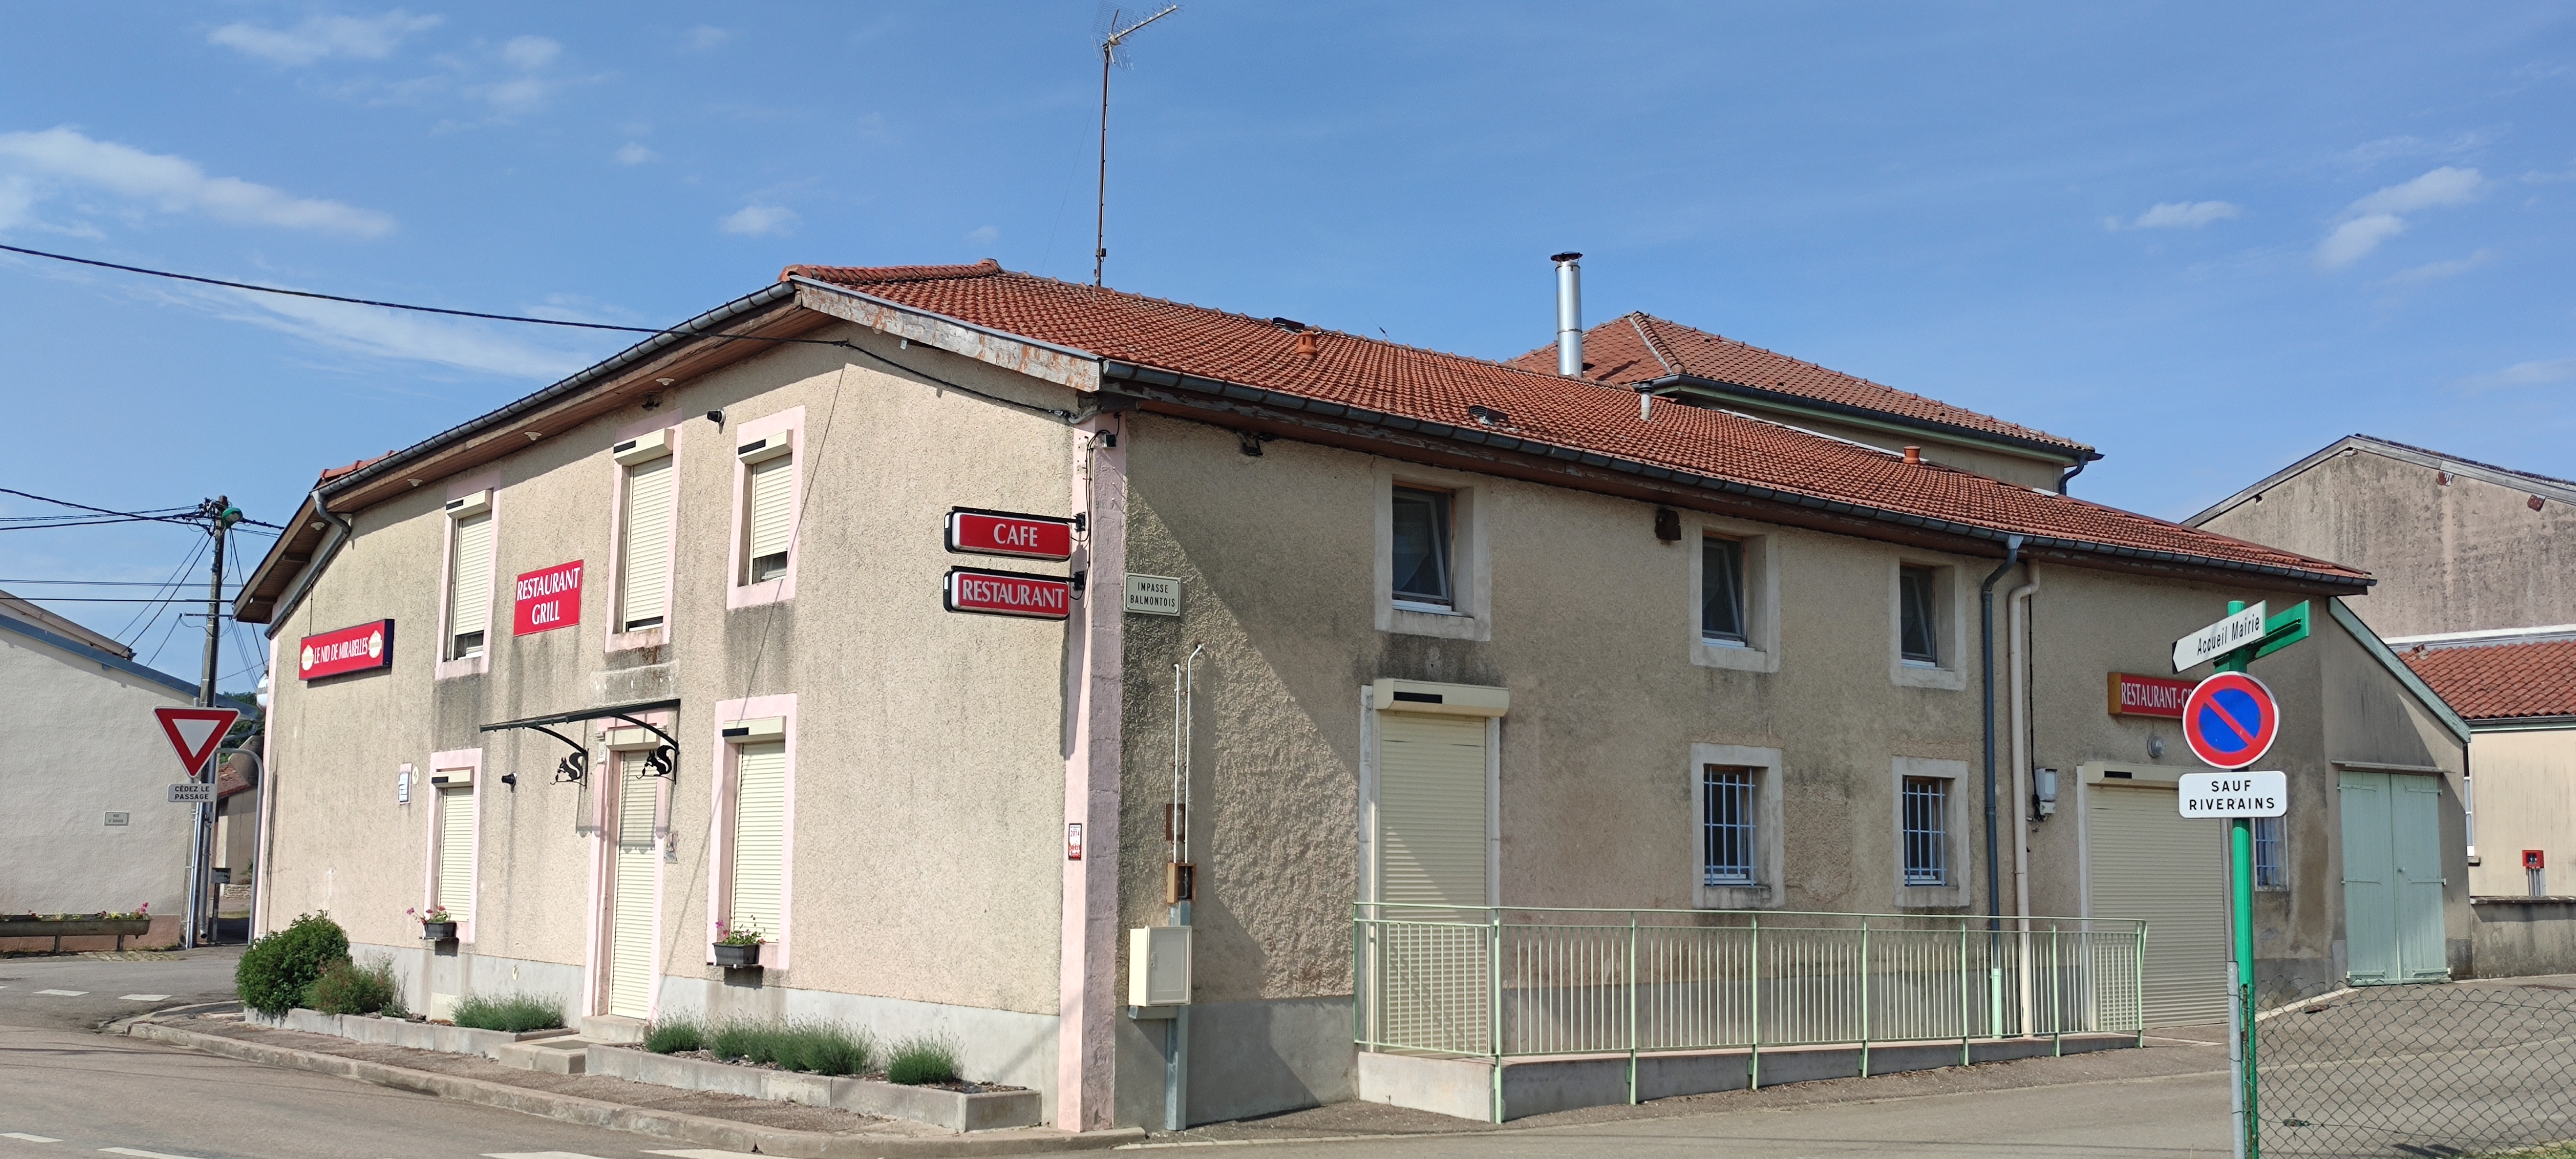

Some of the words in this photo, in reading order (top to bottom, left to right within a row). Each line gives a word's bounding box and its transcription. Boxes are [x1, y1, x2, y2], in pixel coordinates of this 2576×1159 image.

[994, 523, 1037, 547] CAFE
[517, 567, 580, 601] RESTAURANT
[963, 580, 1064, 608] RESTAURANT
[1138, 582, 1168, 593] IMPASSE
[532, 600, 559, 625] GRILL
[1130, 594, 1175, 607] BALMONTOIS
[2197, 626, 2228, 655] Accueil
[2232, 614, 2259, 641] Mairie
[314, 647, 319, 664] LE
[320, 645, 331, 663] NID
[331, 643, 339, 661] DE
[339, 636, 369, 659] MIRABELLES
[2211, 780, 2251, 792] SAUF
[2189, 797, 2275, 810] RIVERAINS
